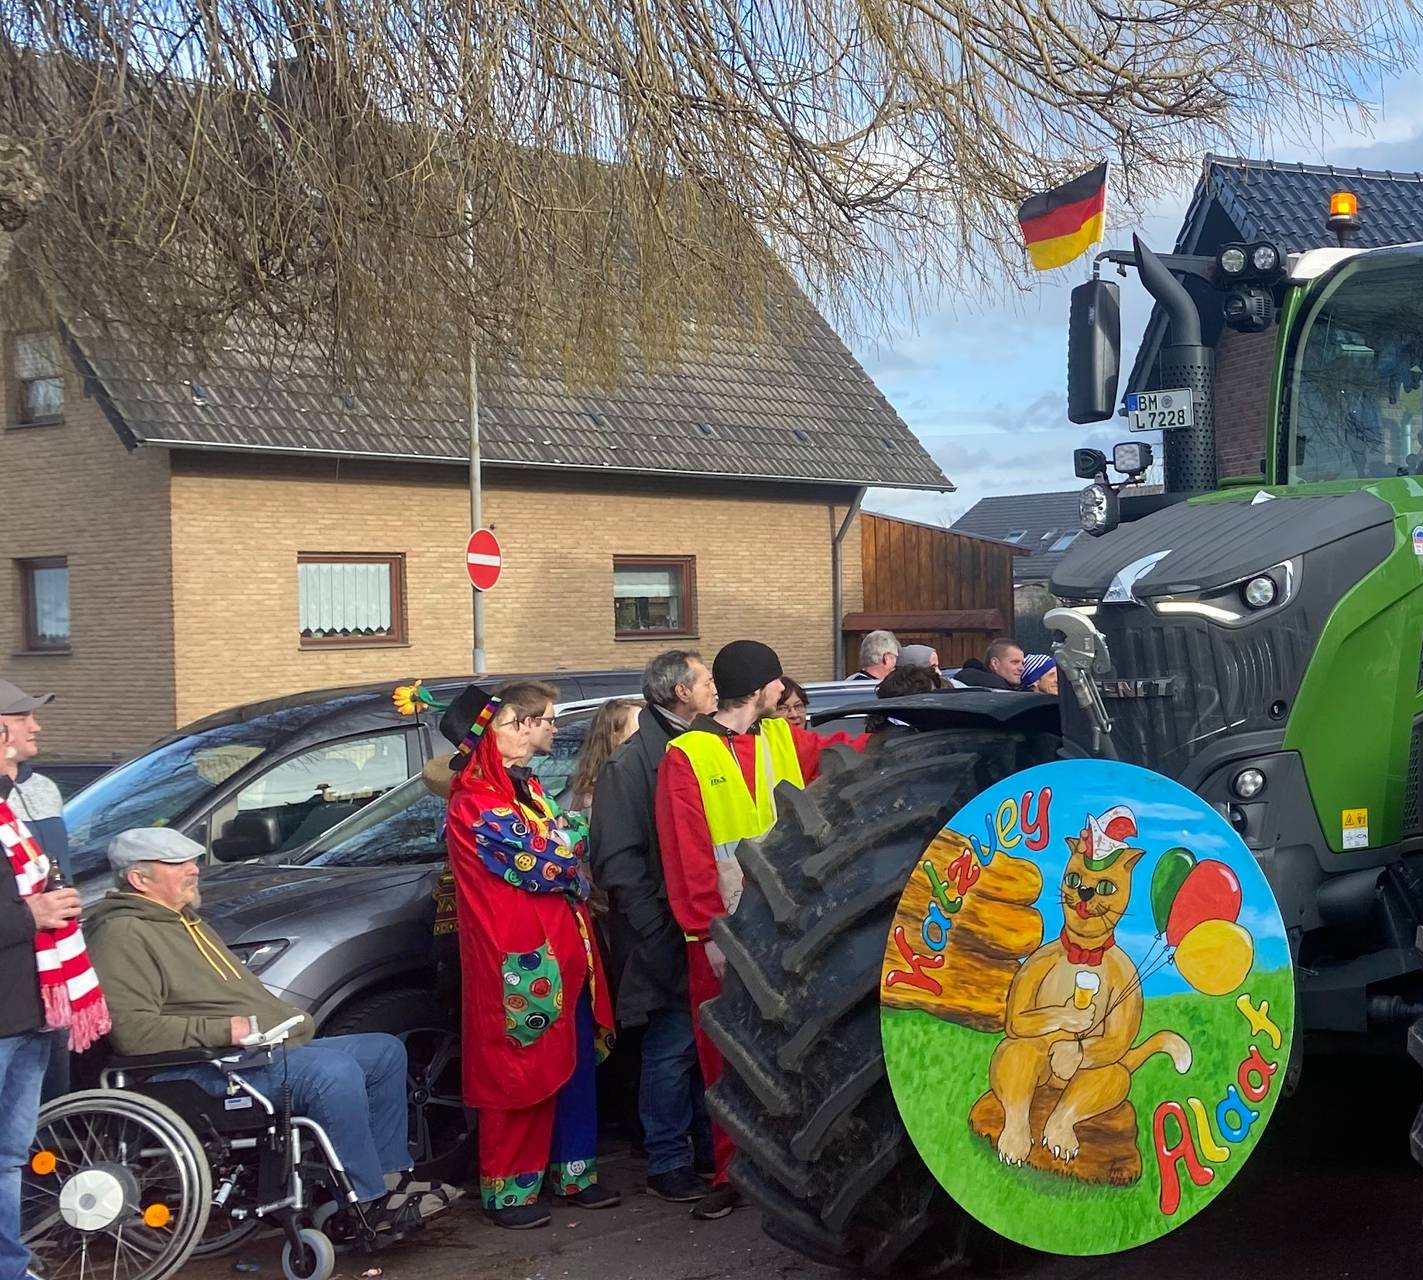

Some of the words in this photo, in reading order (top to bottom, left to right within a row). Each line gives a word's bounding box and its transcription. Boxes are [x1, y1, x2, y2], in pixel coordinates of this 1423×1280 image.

[1138, 395, 1158, 411] BM
[1135, 413, 1146, 429] L
[1148, 409, 1186, 428] 7228
[885, 786, 1053, 996] Katzvey
